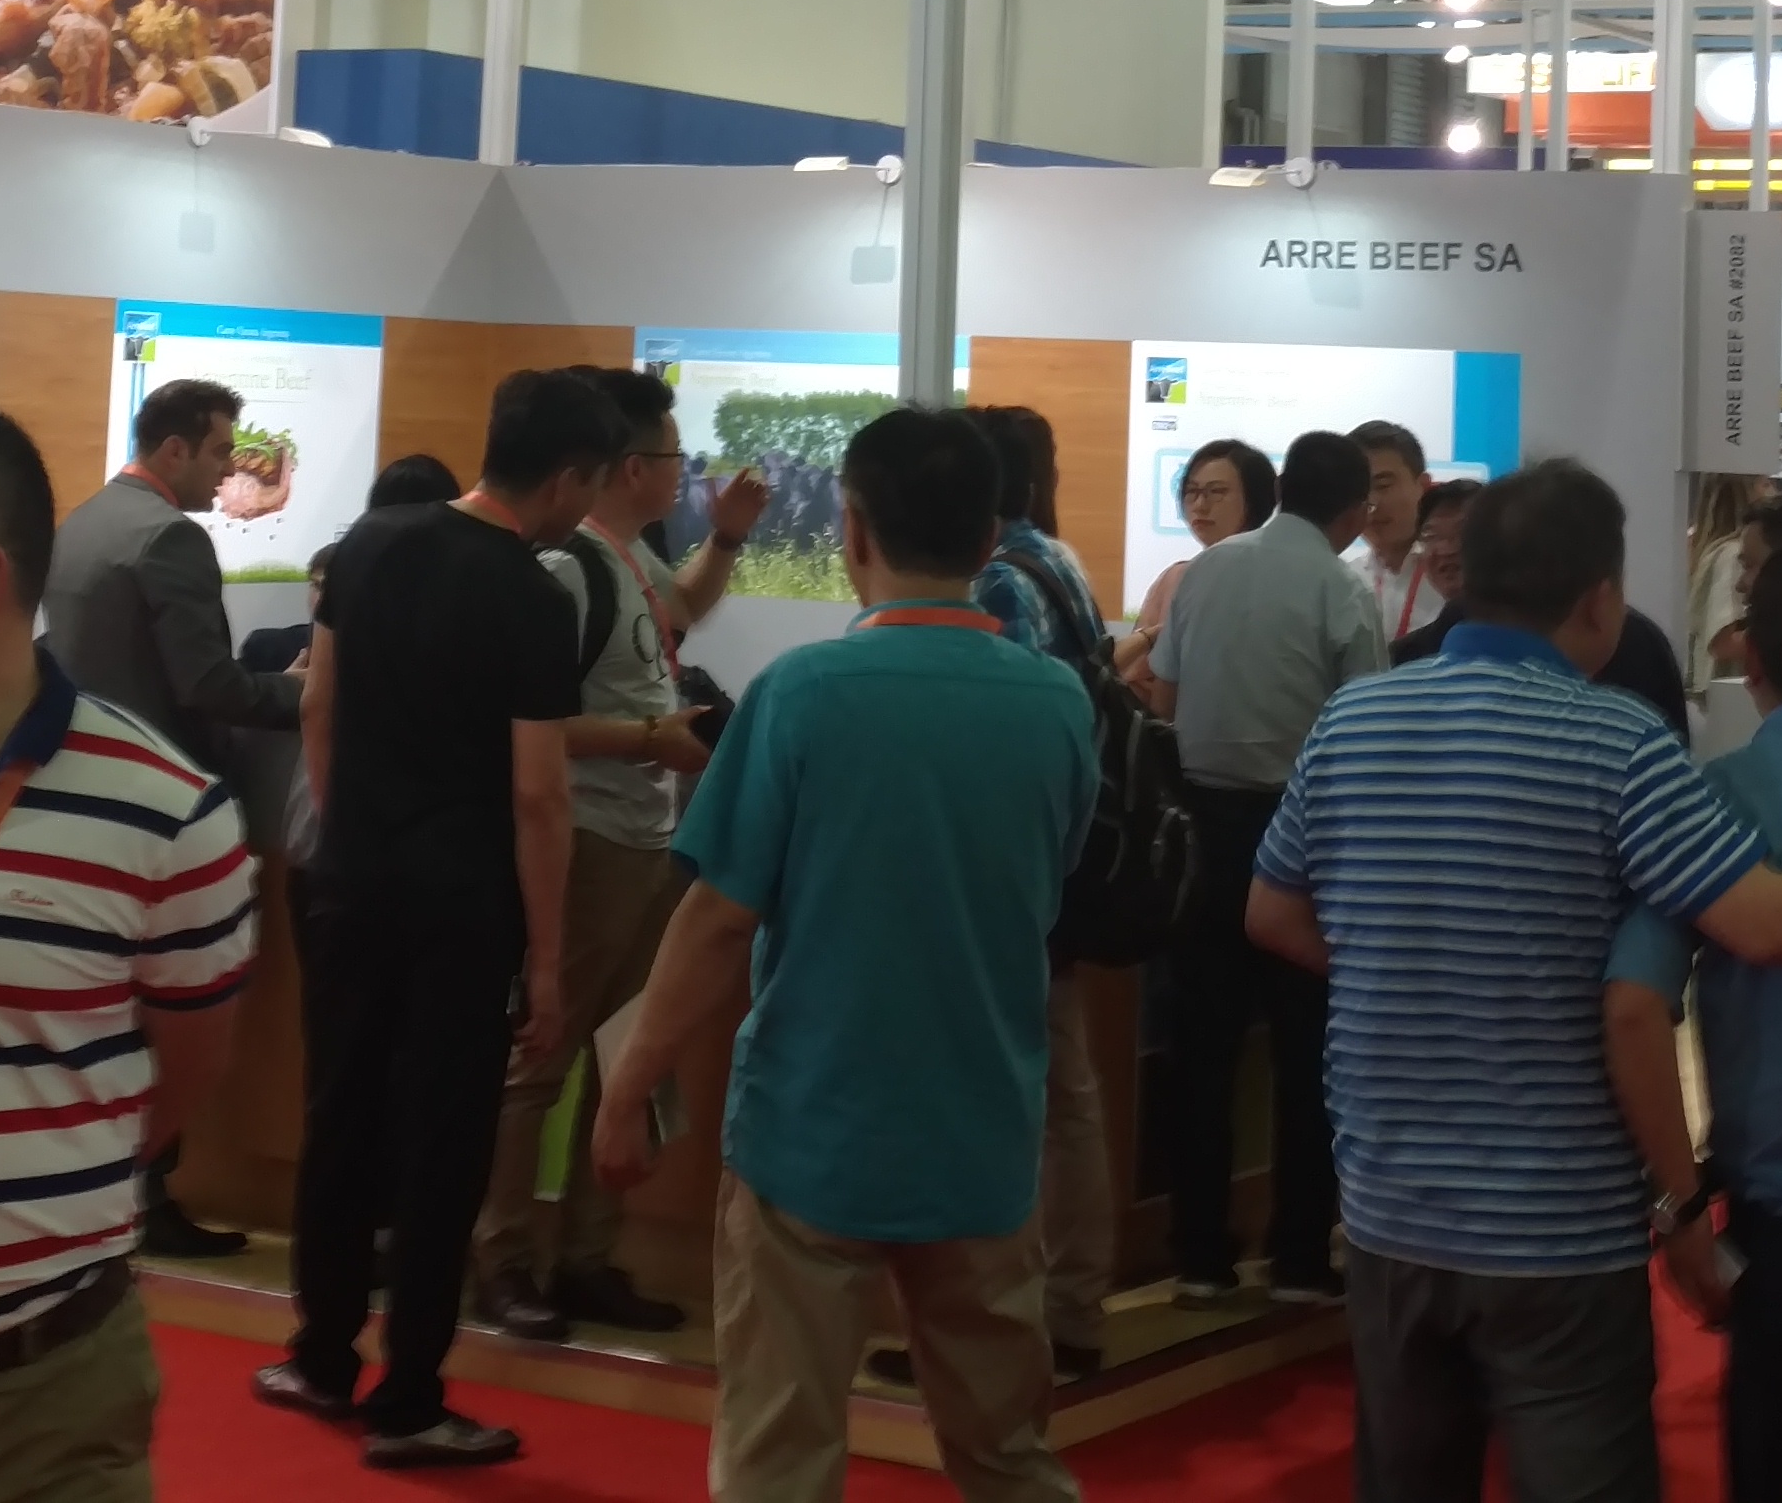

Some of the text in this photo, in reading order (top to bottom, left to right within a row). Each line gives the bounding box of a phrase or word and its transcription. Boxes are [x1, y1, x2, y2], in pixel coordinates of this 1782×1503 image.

[1259, 239, 1523, 272] ARRE BEEF SA
[1725, 234, 1745, 447] ARRE BEEF SA #2082
